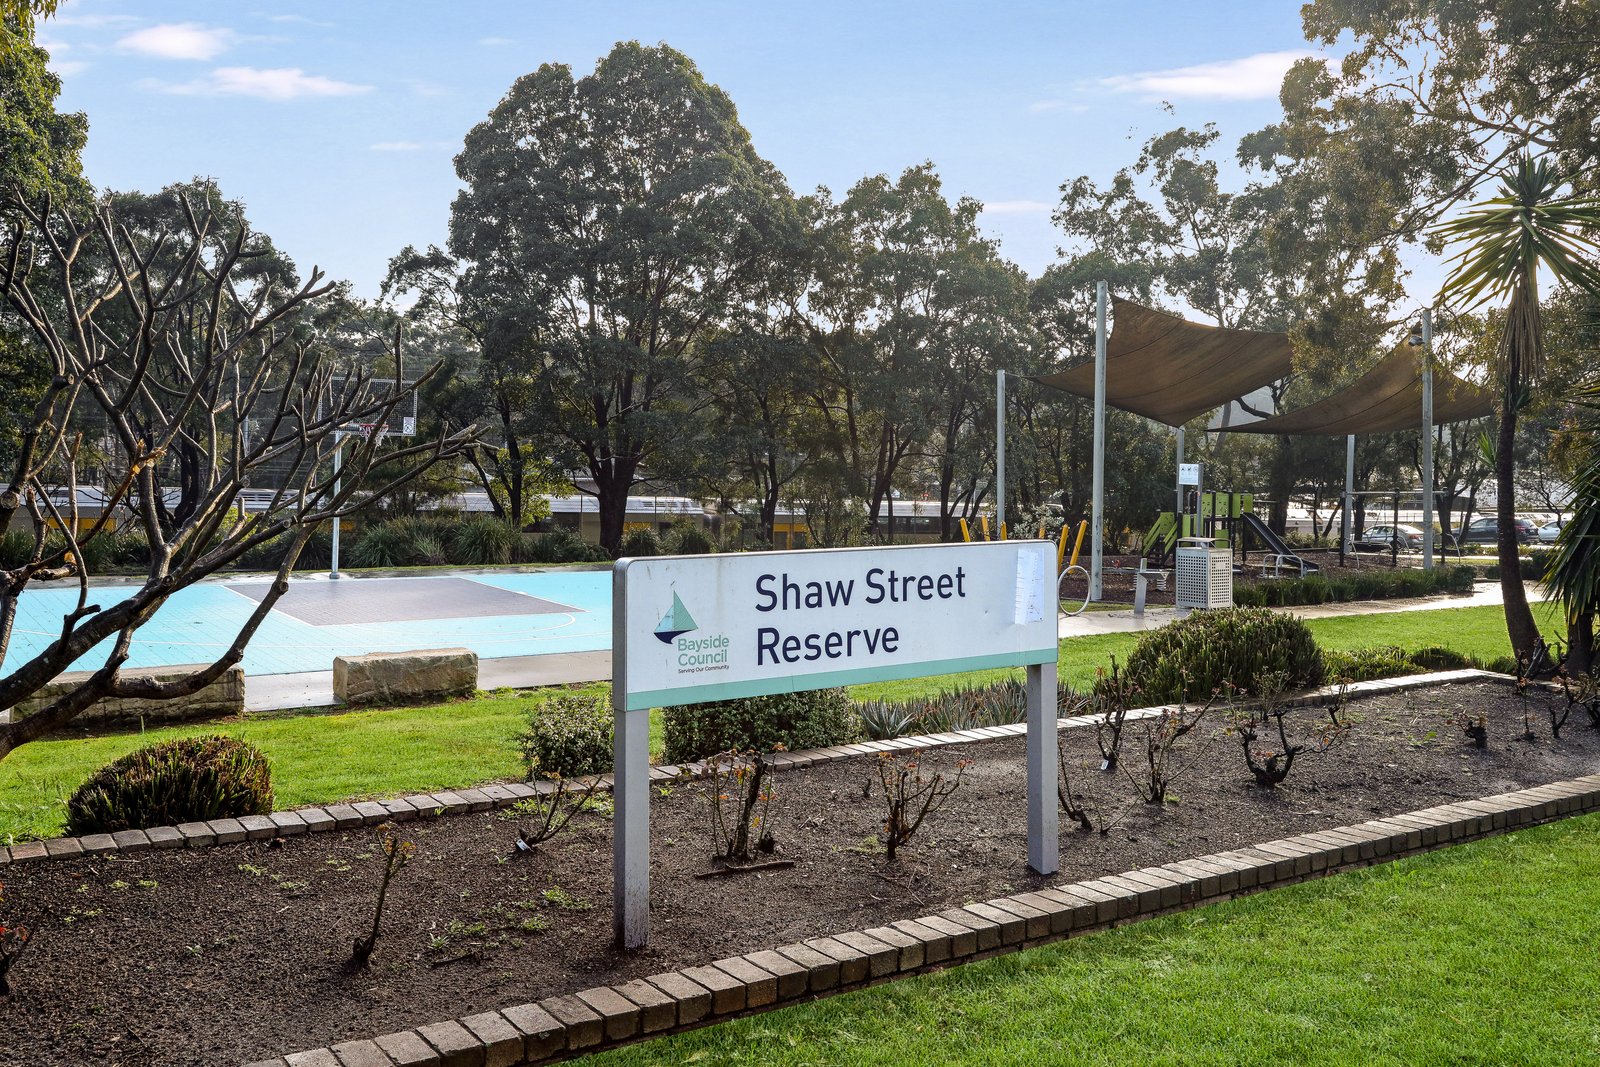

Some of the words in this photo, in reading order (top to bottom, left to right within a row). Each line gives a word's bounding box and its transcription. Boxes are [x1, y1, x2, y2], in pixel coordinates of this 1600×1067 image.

[755, 573, 854, 612] Shaw
[865, 566, 966, 604] Street
[678, 635, 729, 652] Bayside
[678, 649, 728, 666] Council
[757, 626, 899, 666] Reserve
